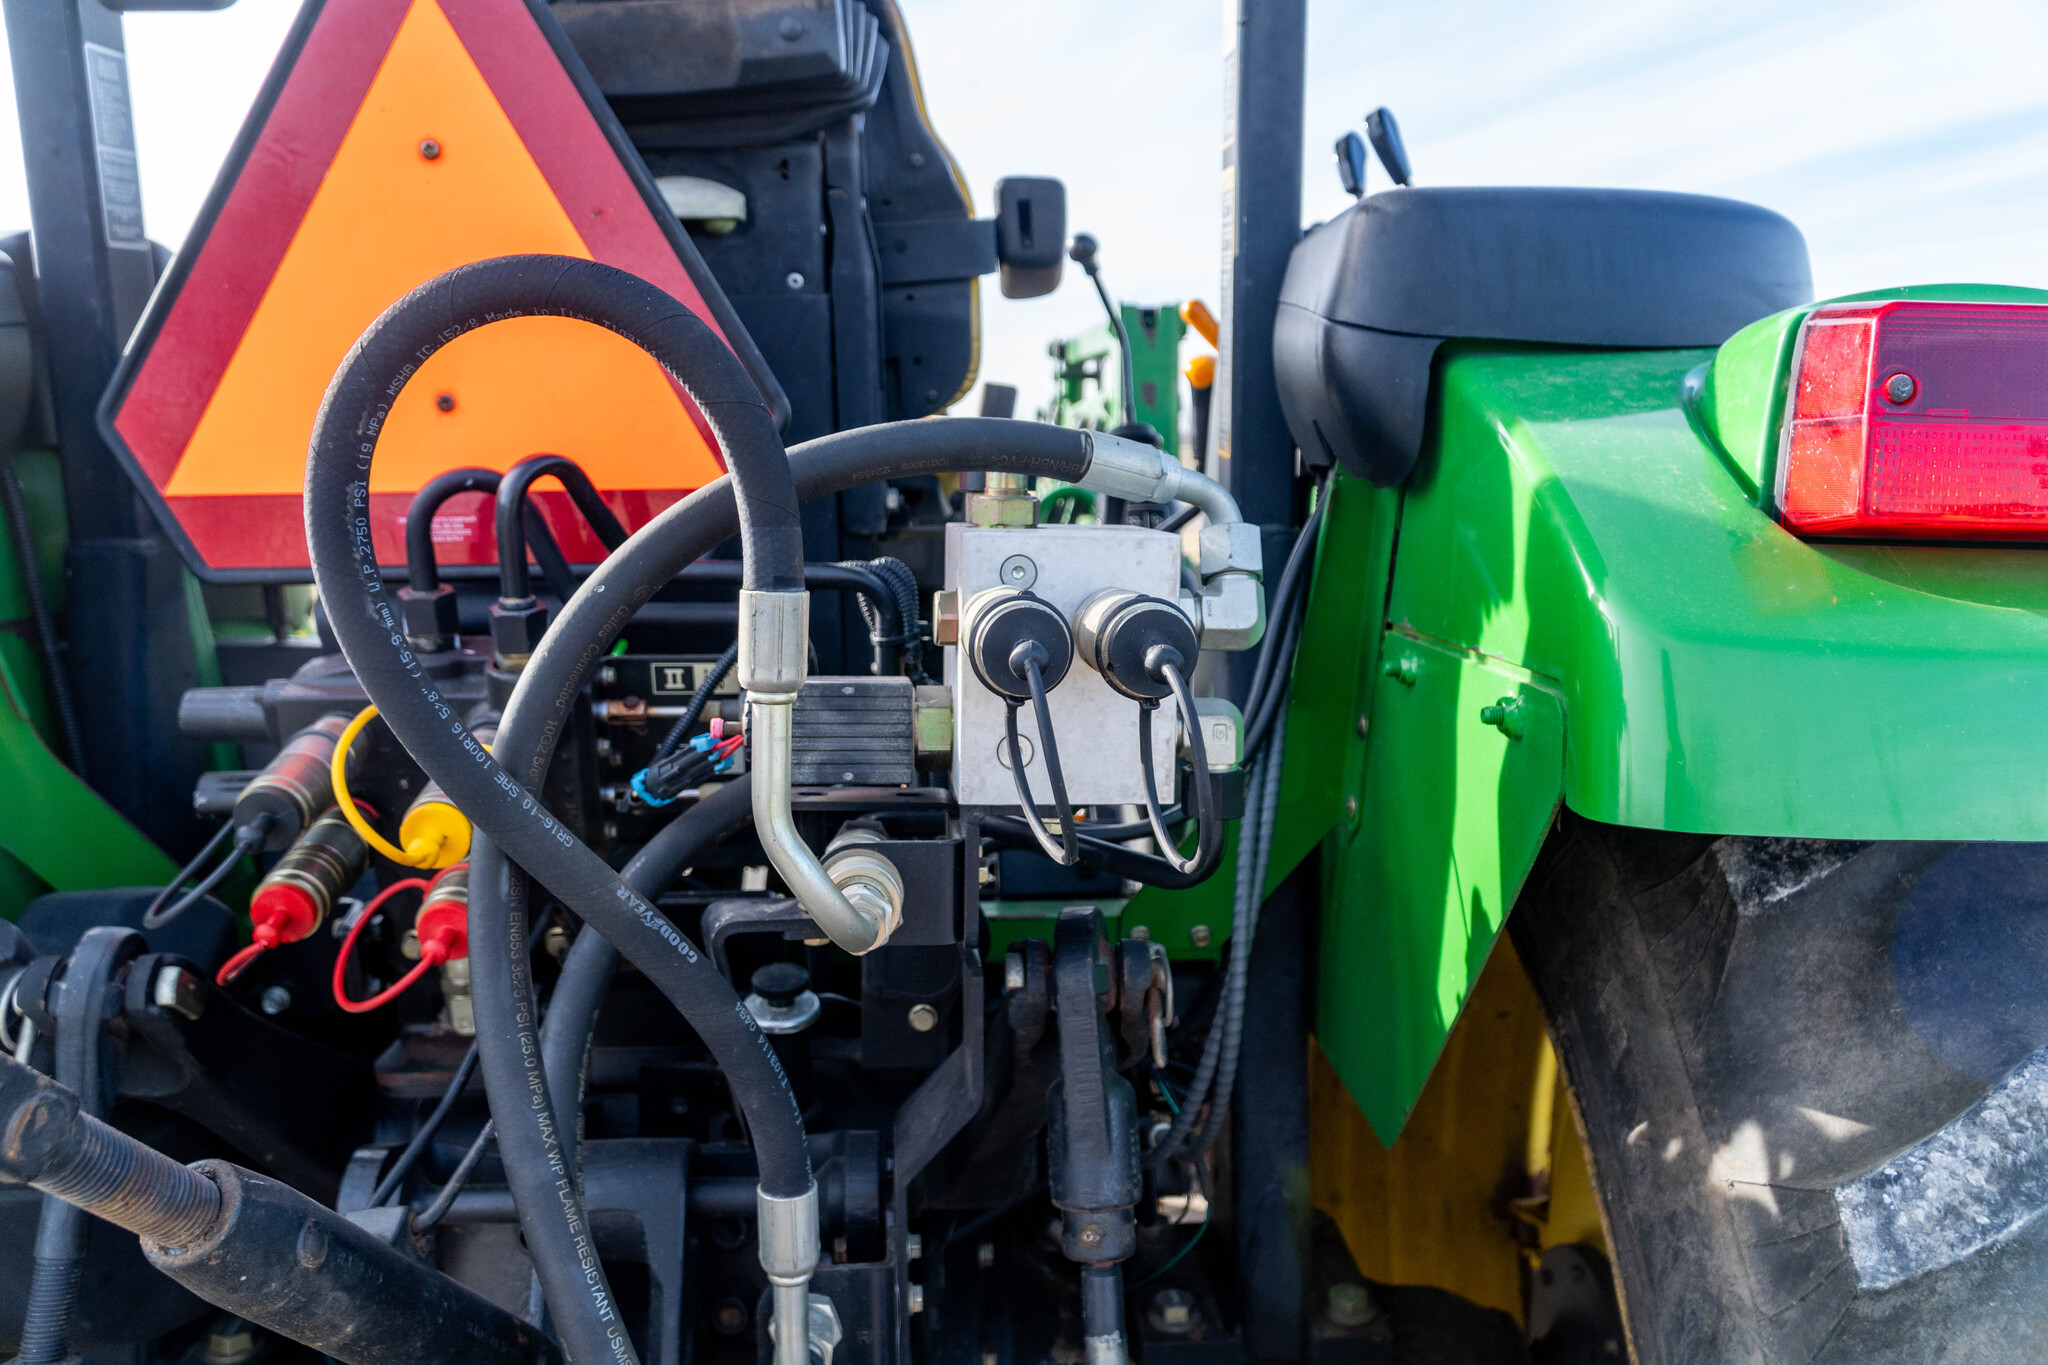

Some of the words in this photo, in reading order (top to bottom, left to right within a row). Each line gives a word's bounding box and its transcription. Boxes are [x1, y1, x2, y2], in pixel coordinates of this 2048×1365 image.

[485, 308, 523, 322] Made
[534, 307, 550, 316] in
[386, 363, 416, 396] MSHA
[366, 403, 388, 436] MPa)
[357, 443, 373, 470] (19
[354, 480, 367, 507] PSI
[376, 602, 394, 627] mm)
[598, 605, 629, 638] Gates
[451, 722, 492, 769] 100R16
[493, 771, 520, 798] SAE
[522, 798, 574, 847] GR16-10
[509, 912, 523, 959] EN853
[616, 885, 698, 964] GOODYEAR
[511, 963, 526, 998] 3625
[516, 1002, 531, 1028] PSI
[735, 1001, 757, 1031] 0494
[517, 1032, 538, 1067] (25.0
[758, 1034, 788, 1088] T103114
[527, 1071, 546, 1109] MPa)
[537, 1111, 558, 1149] MAX
[547, 1149, 565, 1176] WP
[555, 1178, 582, 1234] FLAME
[573, 1235, 615, 1322] RESISTANT
